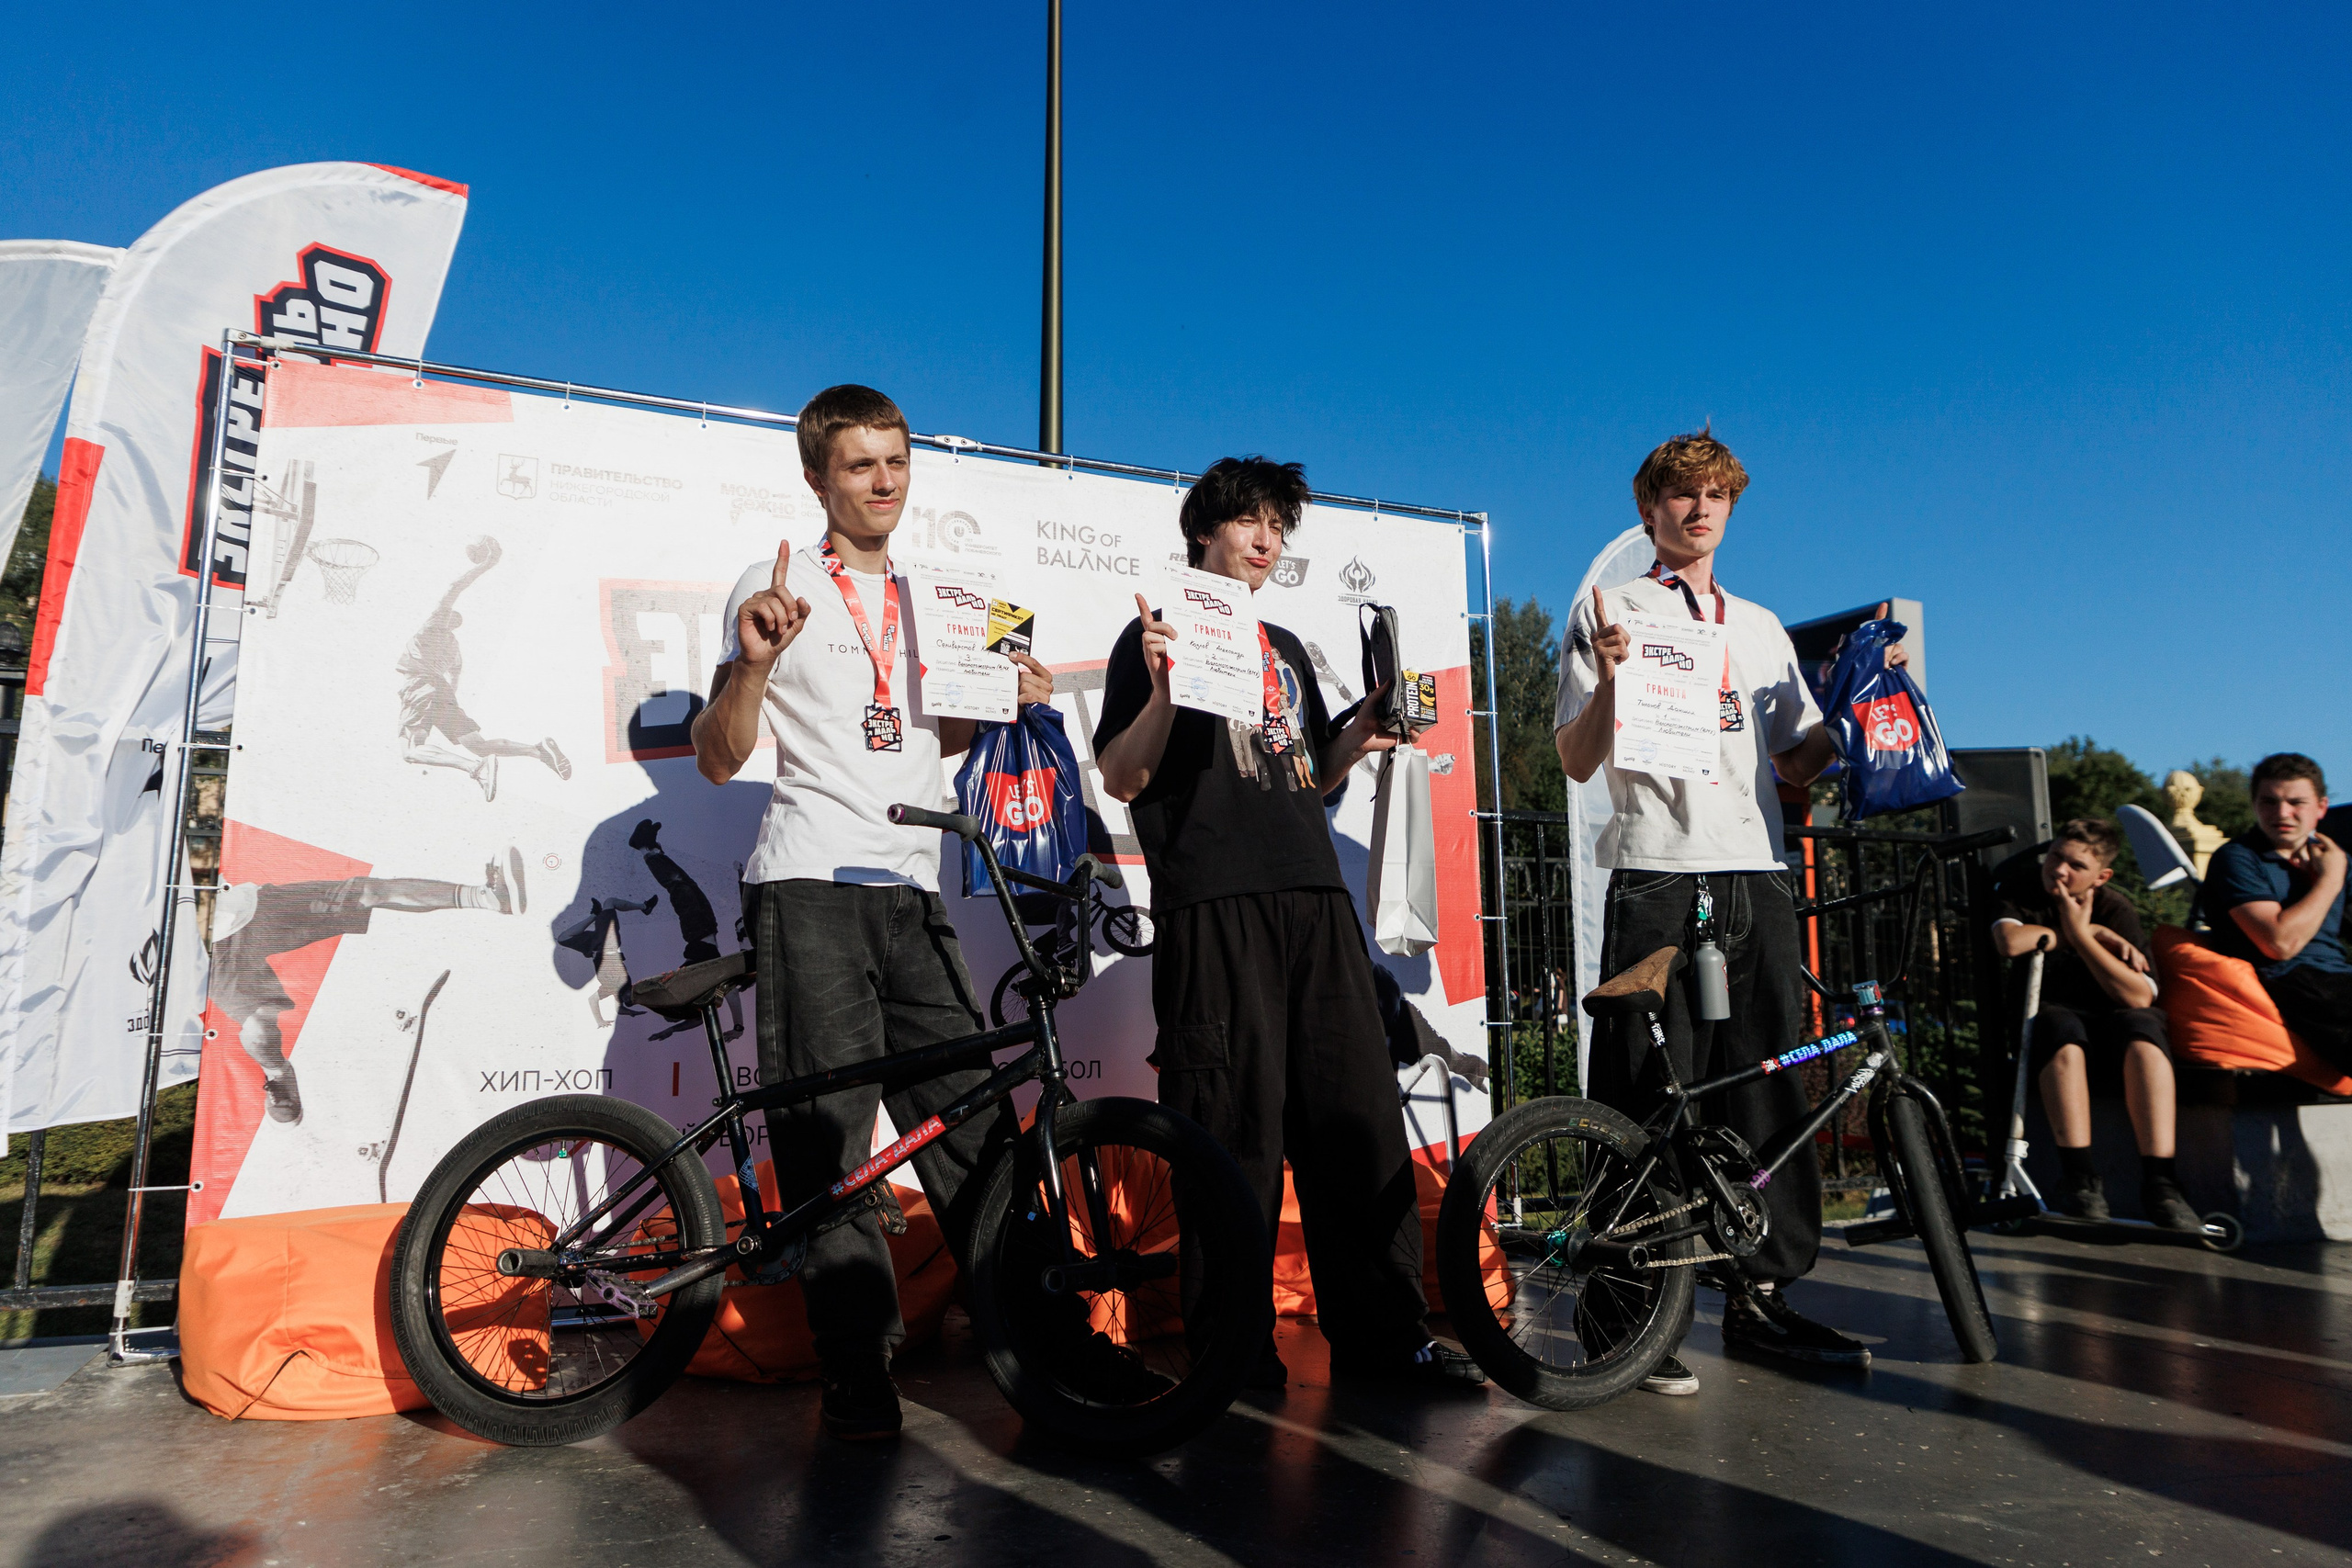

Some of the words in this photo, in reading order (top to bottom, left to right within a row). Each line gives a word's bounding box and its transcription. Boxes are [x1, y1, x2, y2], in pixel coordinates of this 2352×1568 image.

[415, 432, 458, 446] Первые
[550, 462, 684, 490] ПРАВИТЕЛЬСТВО
[550, 479, 671, 502] НИЖЕГОРОДСКОЙ
[548, 491, 613, 507] ОБЛАСТИ
[1036, 519, 1096, 545] KING
[1100, 533, 1122, 547] OF
[1277, 559, 1296, 570] LET'S
[1275, 569, 1299, 585] GO
[936, 588, 963, 598] ЭКСТРЕ
[1185, 590, 1211, 601] ЭКСТРЕ
[947, 623, 986, 637] ГРАМОТА
[1194, 624, 1232, 640] ГРАМОТА
[1644, 645, 1672, 657] ЭКСТРЕ
[1661, 653, 1686, 666] МАЛЬ
[1679, 659, 1692, 670] НО
[1646, 682, 1687, 699] ГРАМОТА
[1406, 681, 1419, 717] PROTEIN
[867, 718, 894, 728] ЭКСТРЕ
[874, 726, 897, 737] МАЛЬ
[881, 733, 894, 742] НО
[1875, 717, 1914, 746] GO
[1006, 795, 1045, 826] GO
[480, 1068, 613, 1092] ХИП-ХОП
[831, 1118, 942, 1196] #СЕЛА-ДАЛА
